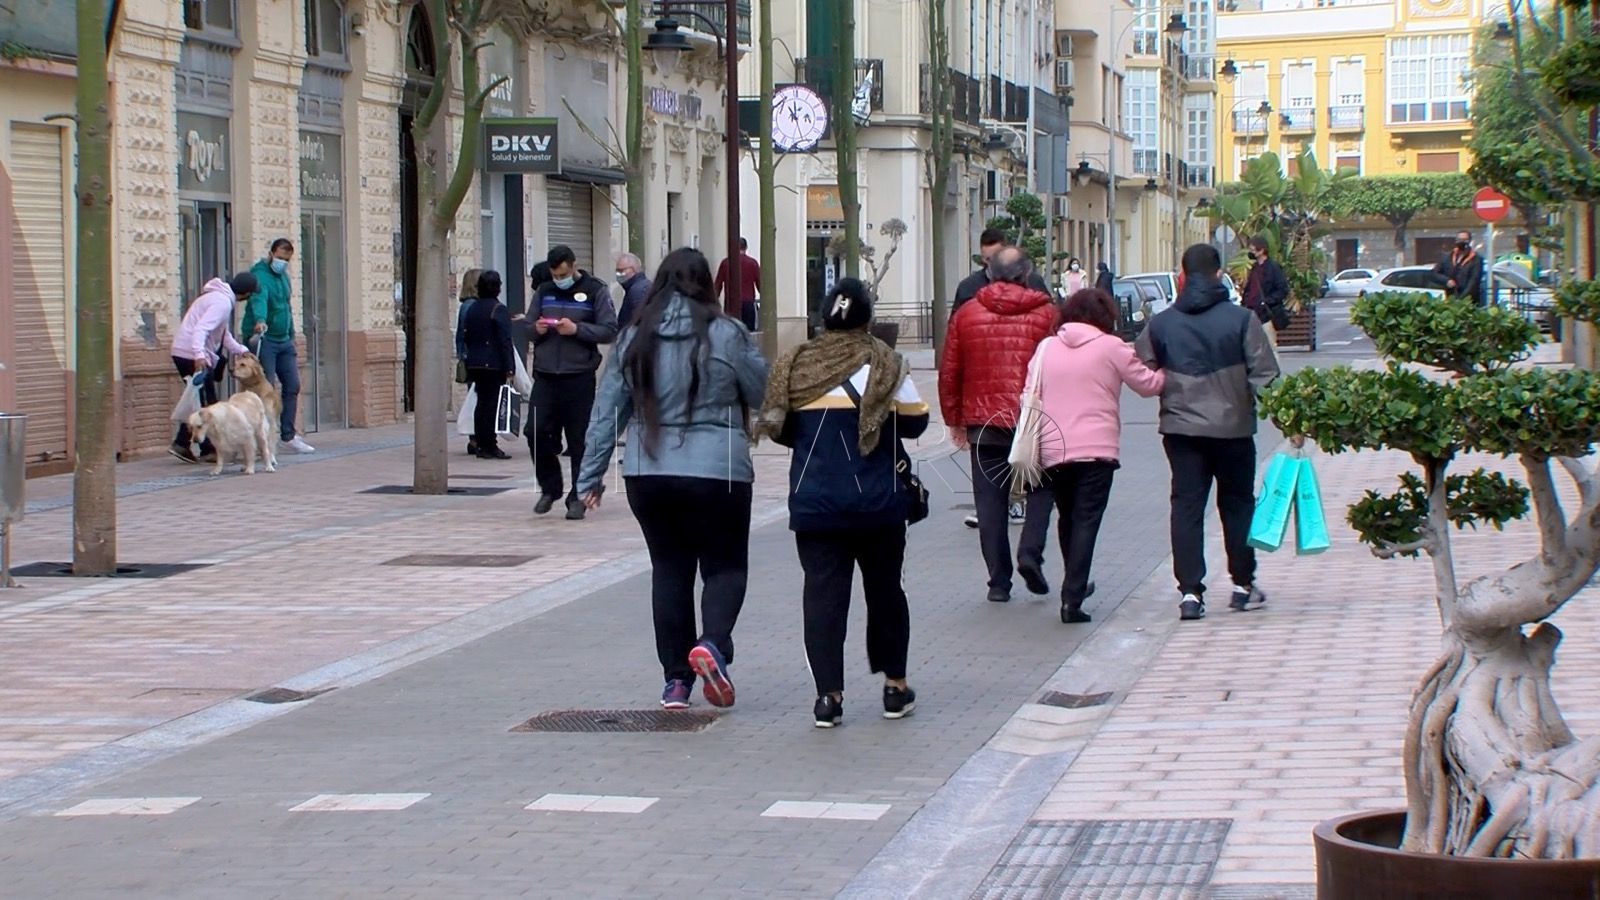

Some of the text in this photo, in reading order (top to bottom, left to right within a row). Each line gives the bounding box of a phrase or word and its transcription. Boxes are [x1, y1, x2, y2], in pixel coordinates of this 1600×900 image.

[491, 135, 551, 152] DKV
[187, 130, 225, 183] Royal
[491, 153, 512, 161] Salud
[518, 153, 552, 161] bienestar
